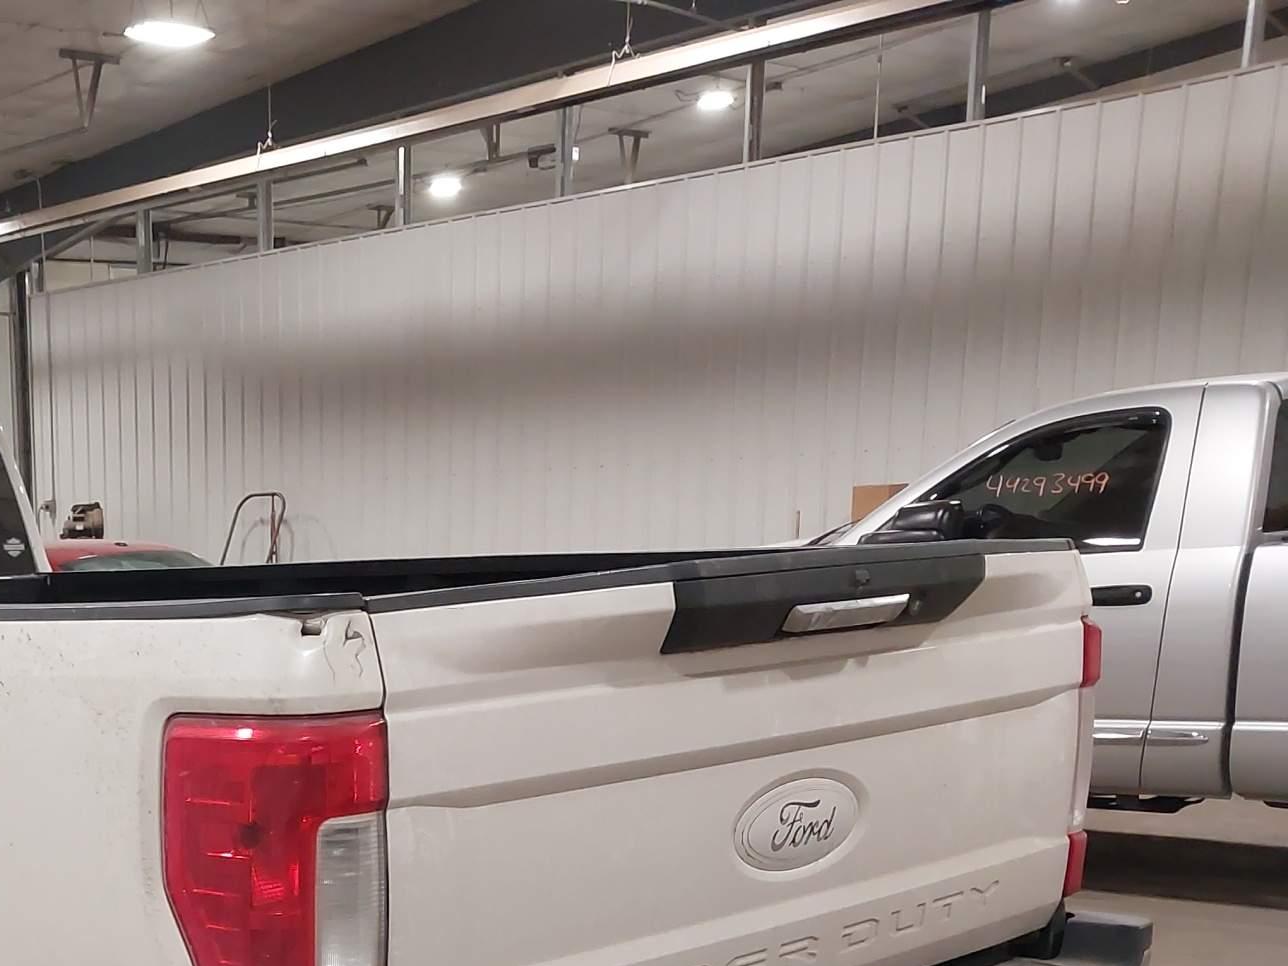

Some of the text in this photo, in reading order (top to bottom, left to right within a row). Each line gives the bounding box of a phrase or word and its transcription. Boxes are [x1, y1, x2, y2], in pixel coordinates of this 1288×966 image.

[985, 471, 1110, 498] 44293499
[771, 799, 837, 852] Ford
[840, 878, 1000, 950] DUTY
